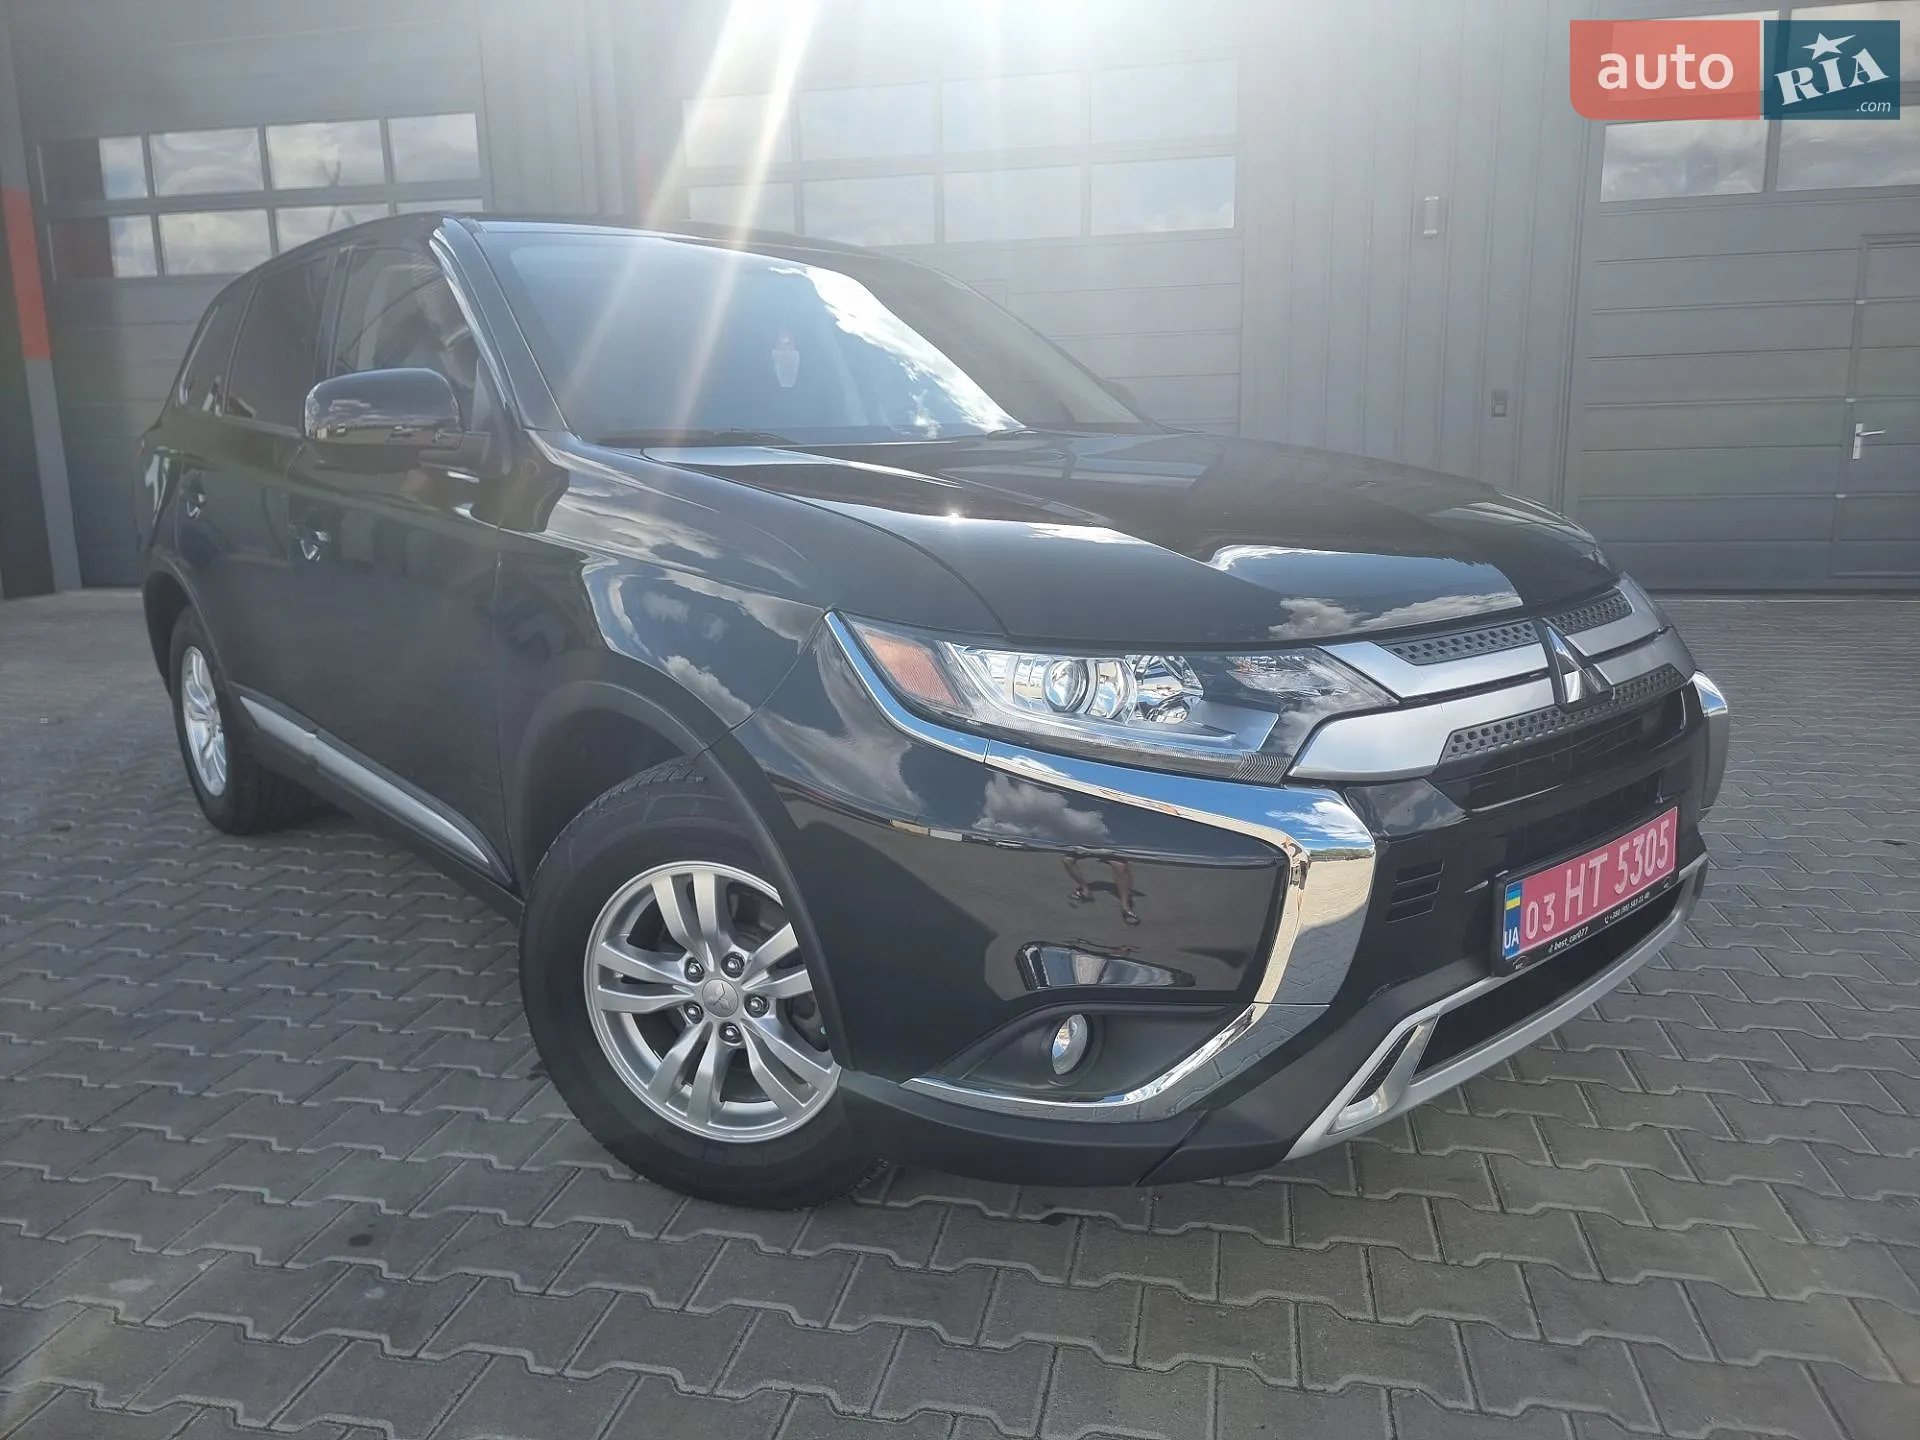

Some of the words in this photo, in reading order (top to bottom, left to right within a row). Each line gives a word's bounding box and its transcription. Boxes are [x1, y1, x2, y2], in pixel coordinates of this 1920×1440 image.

[1525, 892, 1556, 940] 03
[1564, 852, 1608, 922] HT
[1614, 819, 1670, 895] 5305
[1504, 926, 1520, 949] UA
